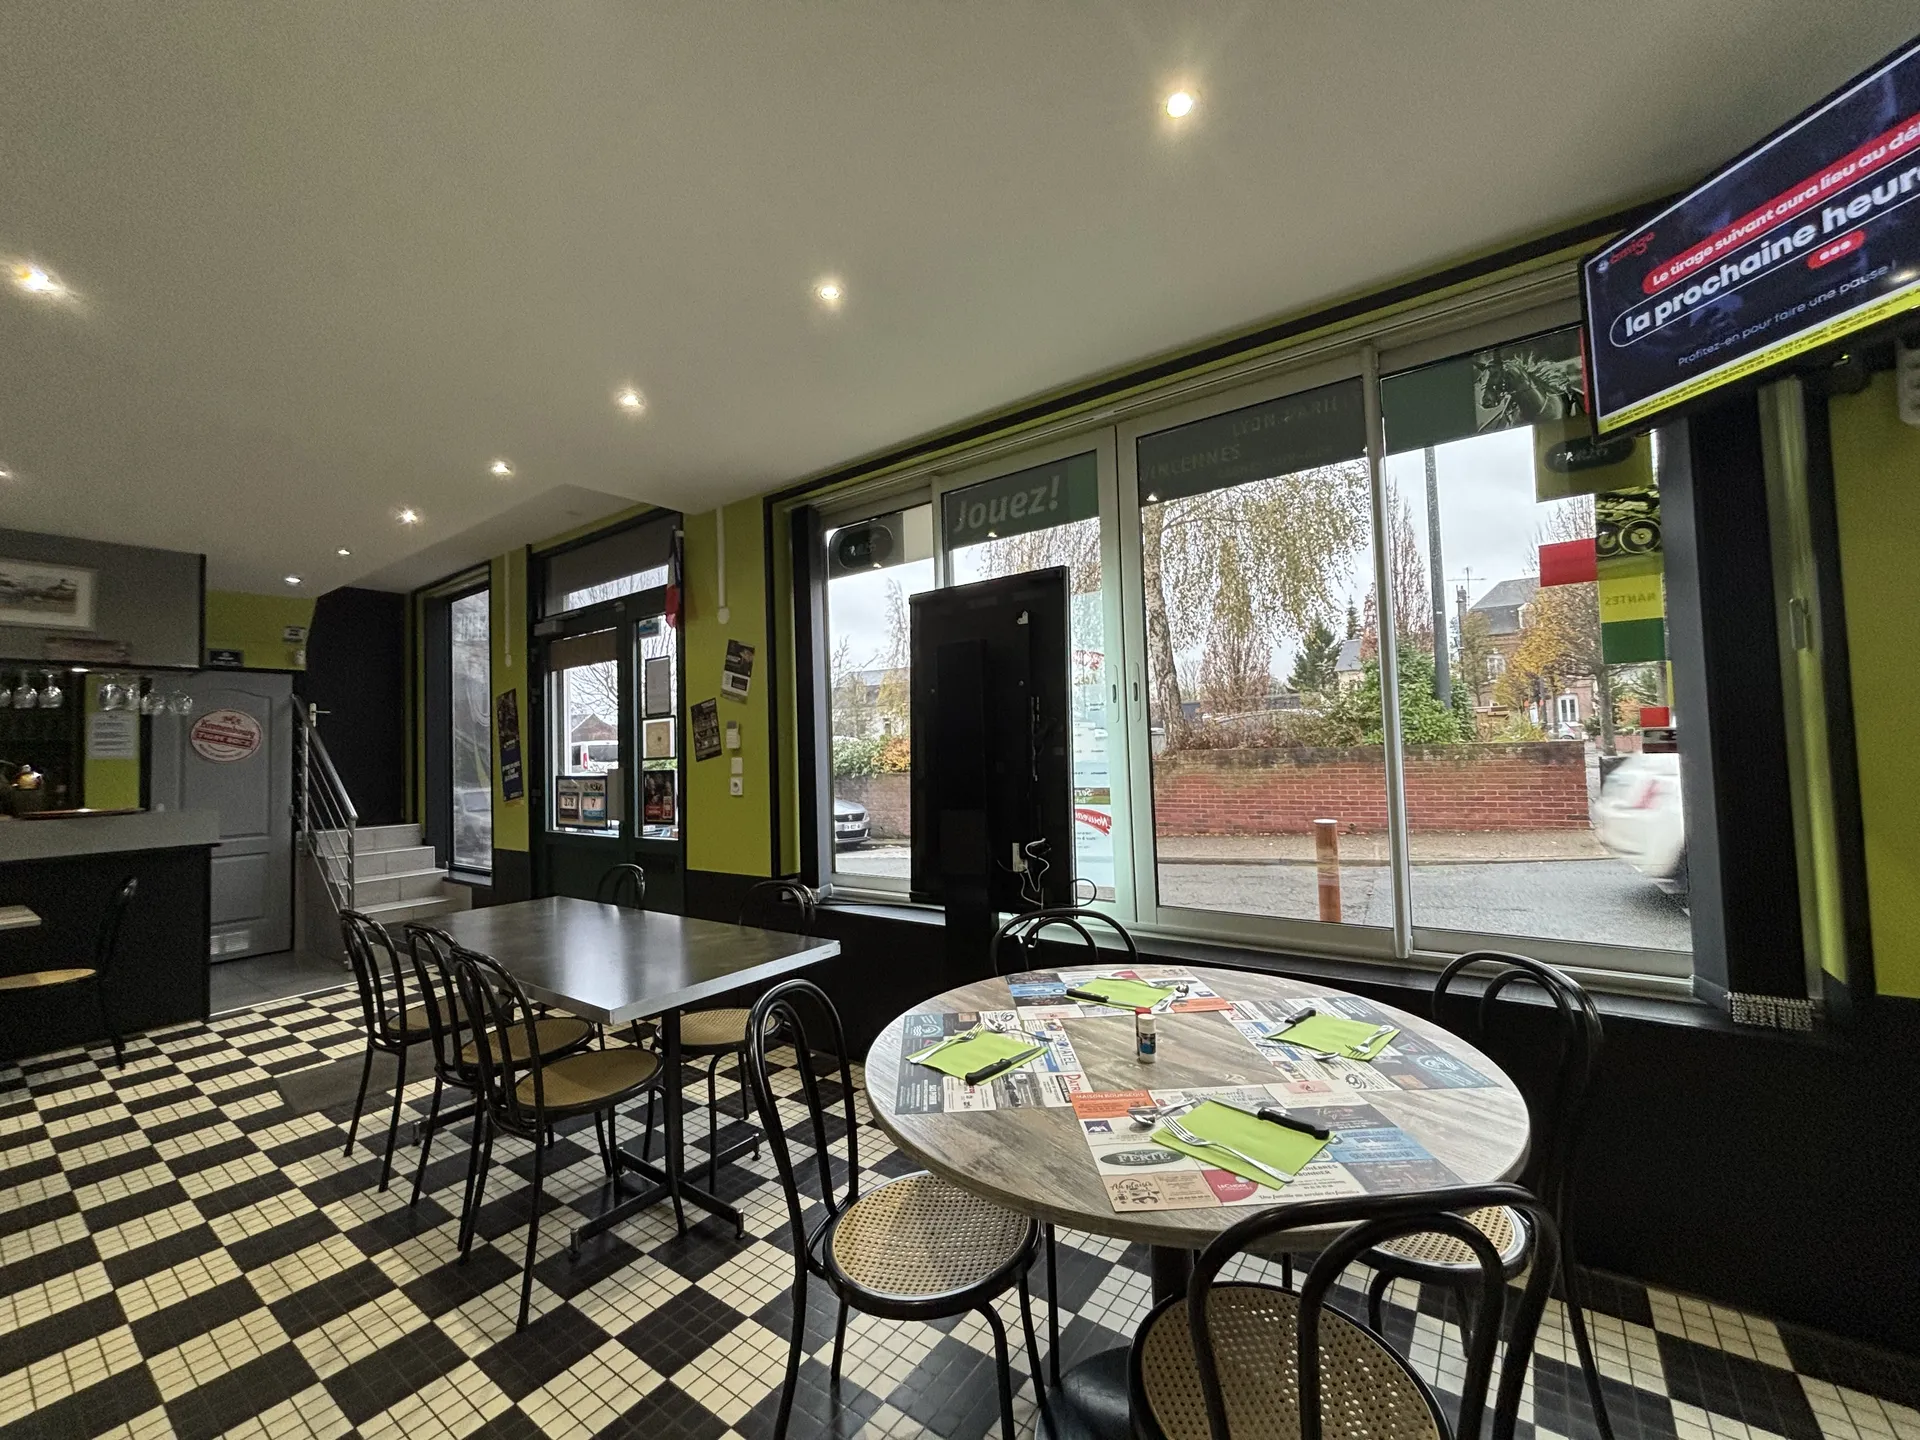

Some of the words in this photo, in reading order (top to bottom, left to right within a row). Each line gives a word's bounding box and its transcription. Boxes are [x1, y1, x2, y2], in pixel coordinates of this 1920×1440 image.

[1652, 271, 1669, 286] Le
[1670, 246, 1714, 276] tirage
[1714, 209, 1776, 251] suivant
[1775, 185, 1819, 215] aura
[1819, 163, 1856, 190] lieu
[1858, 146, 1888, 168] au
[1888, 120, 1920, 150] dé
[1624, 311, 1650, 338] la
[1653, 223, 1818, 327] prochaine
[1677, 333, 1741, 367] Profitez-en
[1742, 318, 1773, 340] pour
[1774, 301, 1807, 323] faire
[1808, 289, 1837, 307] une
[1838, 265, 1889, 295] pause
[953, 475, 1060, 534] Jouez!
[1088, 1125, 1109, 1134] AXA
